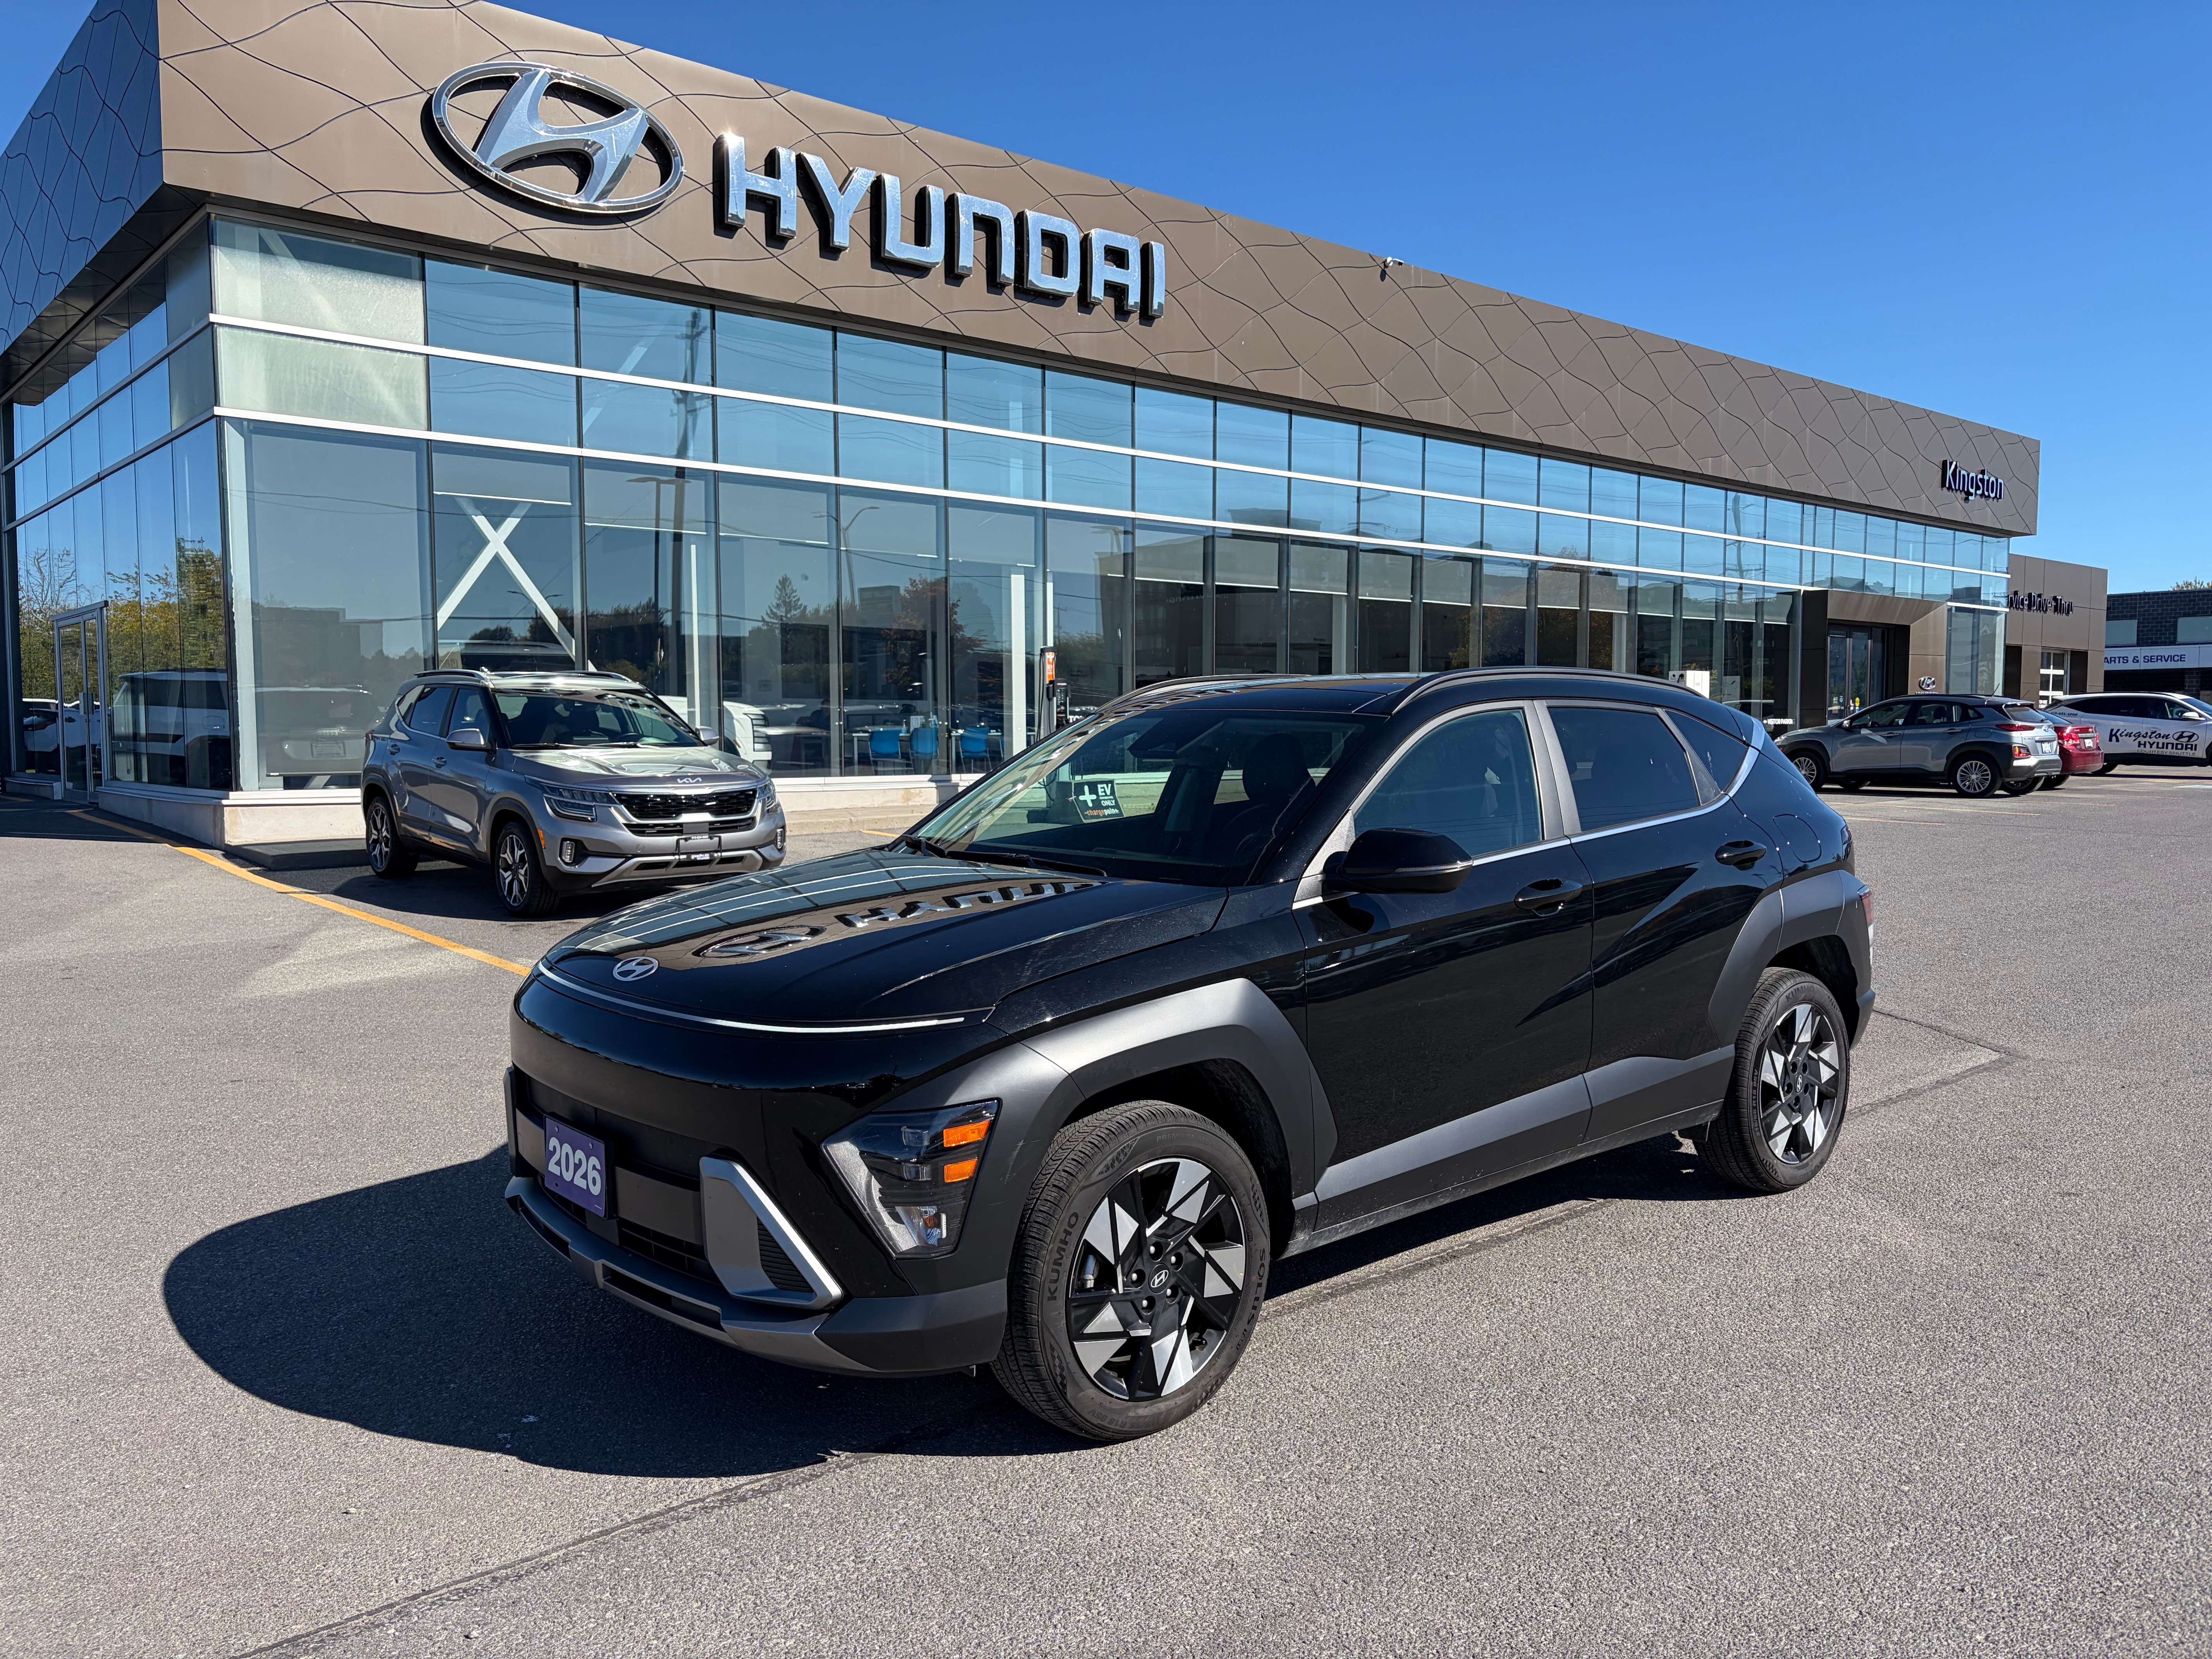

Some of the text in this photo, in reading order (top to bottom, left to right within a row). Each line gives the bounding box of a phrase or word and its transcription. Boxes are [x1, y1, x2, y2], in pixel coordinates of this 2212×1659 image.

[715, 132, 1165, 319] HYUNDAI
[1943, 459, 2004, 500] Kingston
[2104, 656, 2129, 664] ARTS
[2143, 654, 2186, 663] SERVICE
[2109, 728, 2171, 742] Kingston
[2138, 740, 2198, 751] HYUNDAI
[1097, 783, 1111, 796] EV
[1786, 986, 1815, 1002] KUMHO
[548, 1137, 601, 1196] 2026
[1047, 1211, 1079, 1301] KUMHO
[1247, 1247, 1266, 1326] SOLUS
